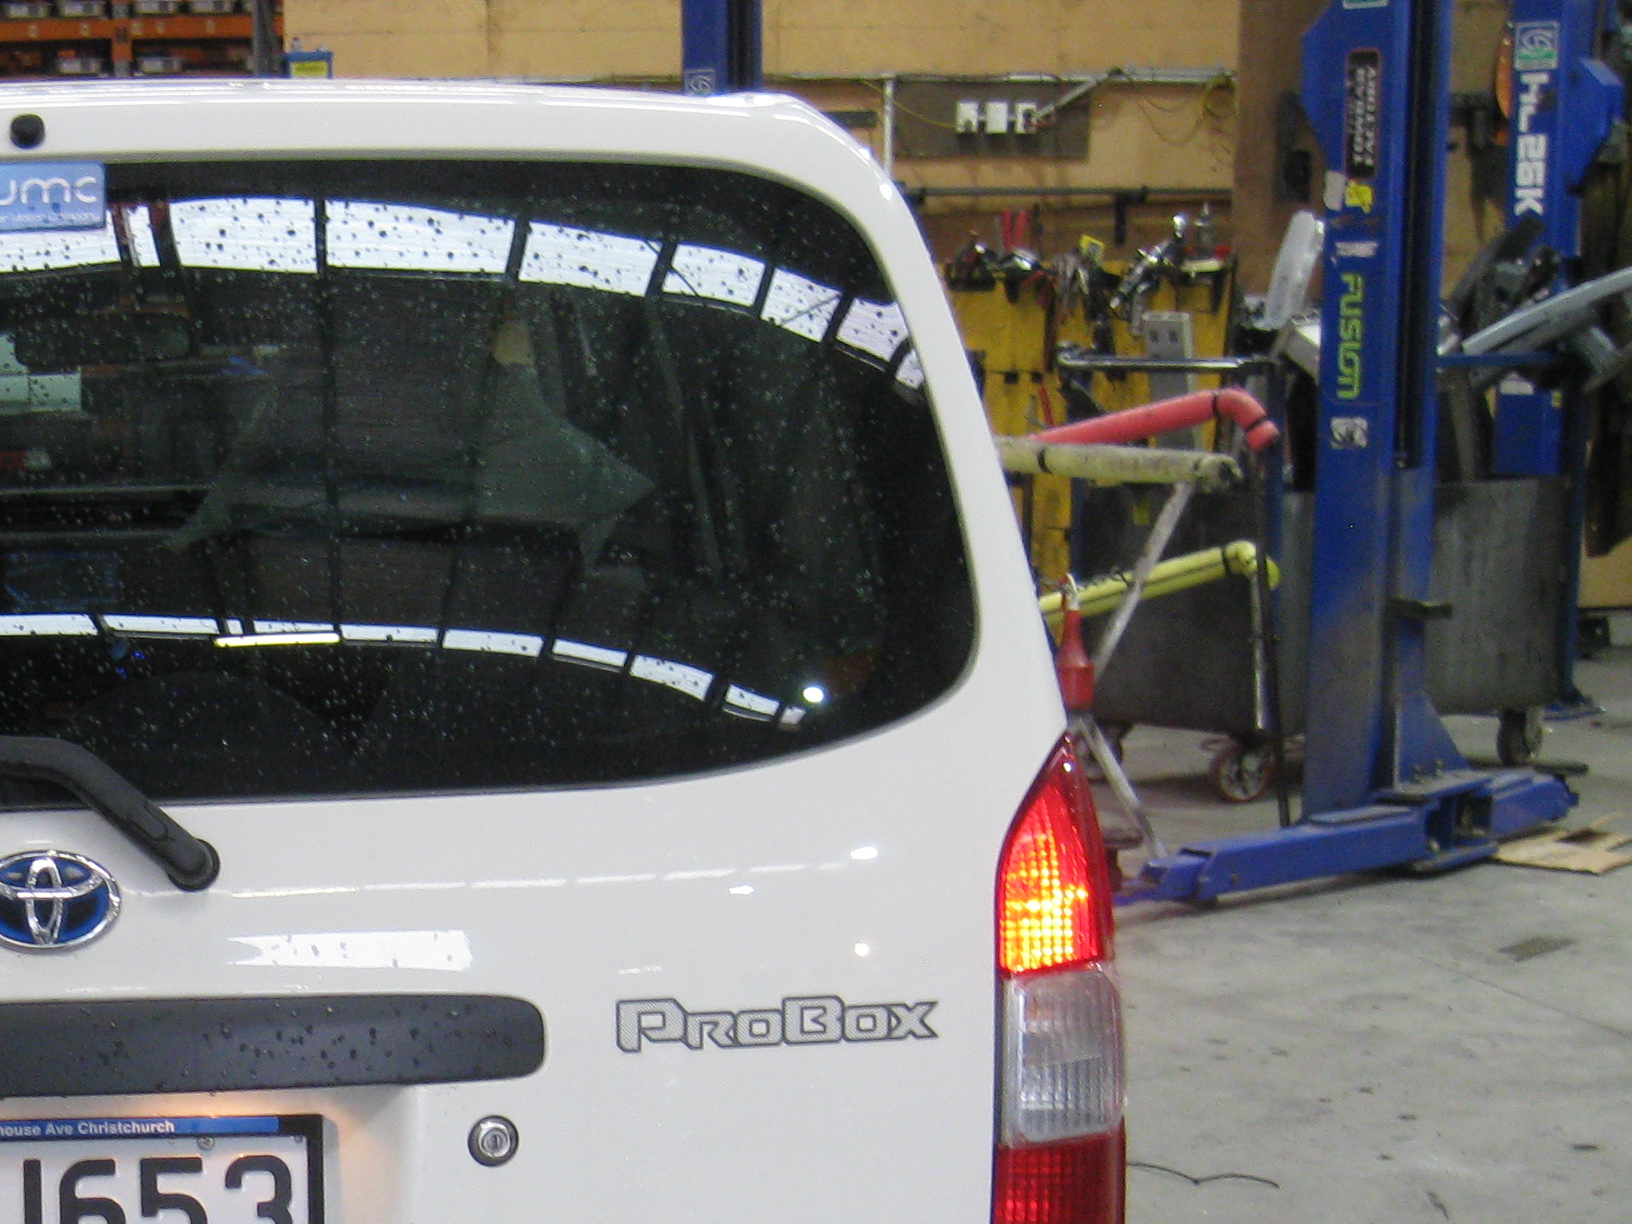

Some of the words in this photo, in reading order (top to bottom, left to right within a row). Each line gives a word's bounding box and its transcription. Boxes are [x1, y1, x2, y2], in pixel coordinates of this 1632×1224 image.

[616, 994, 939, 1052] ProBox
[45, 1122, 74, 1136] Ave
[76, 1120, 176, 1135] Christchurch
